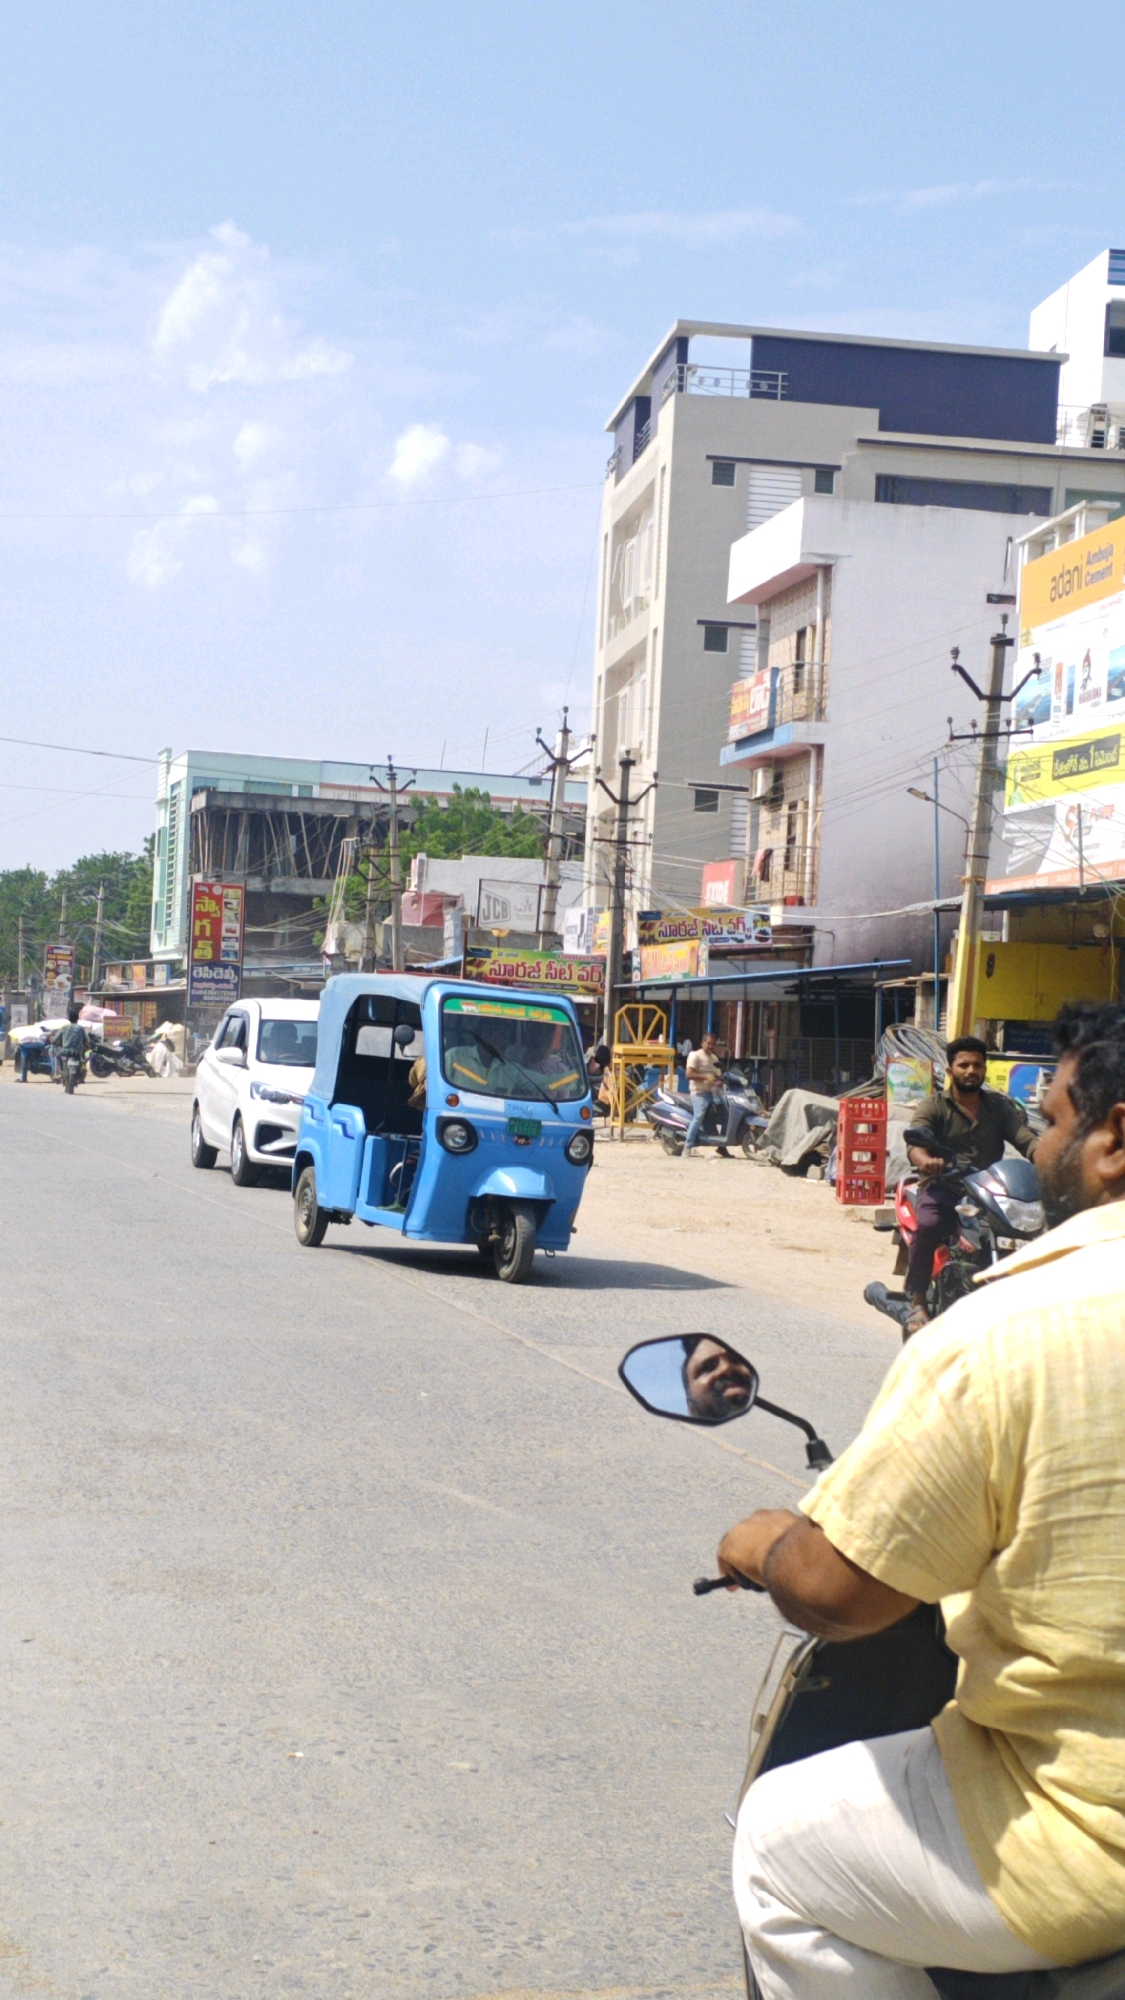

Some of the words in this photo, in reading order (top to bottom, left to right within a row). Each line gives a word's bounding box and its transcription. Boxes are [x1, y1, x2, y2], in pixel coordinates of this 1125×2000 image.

[1086, 543, 1114, 567] Ambuja
[1050, 554, 1084, 603] adani
[1085, 562, 1113, 587] Cement
[1089, 744, 1095, 768] 1
[706, 880, 729, 906] EXIDE
[482, 893, 509, 921] JCB
[489, 959, 542, 979] సూరజ్
[545, 960, 574, 981] సీట్
